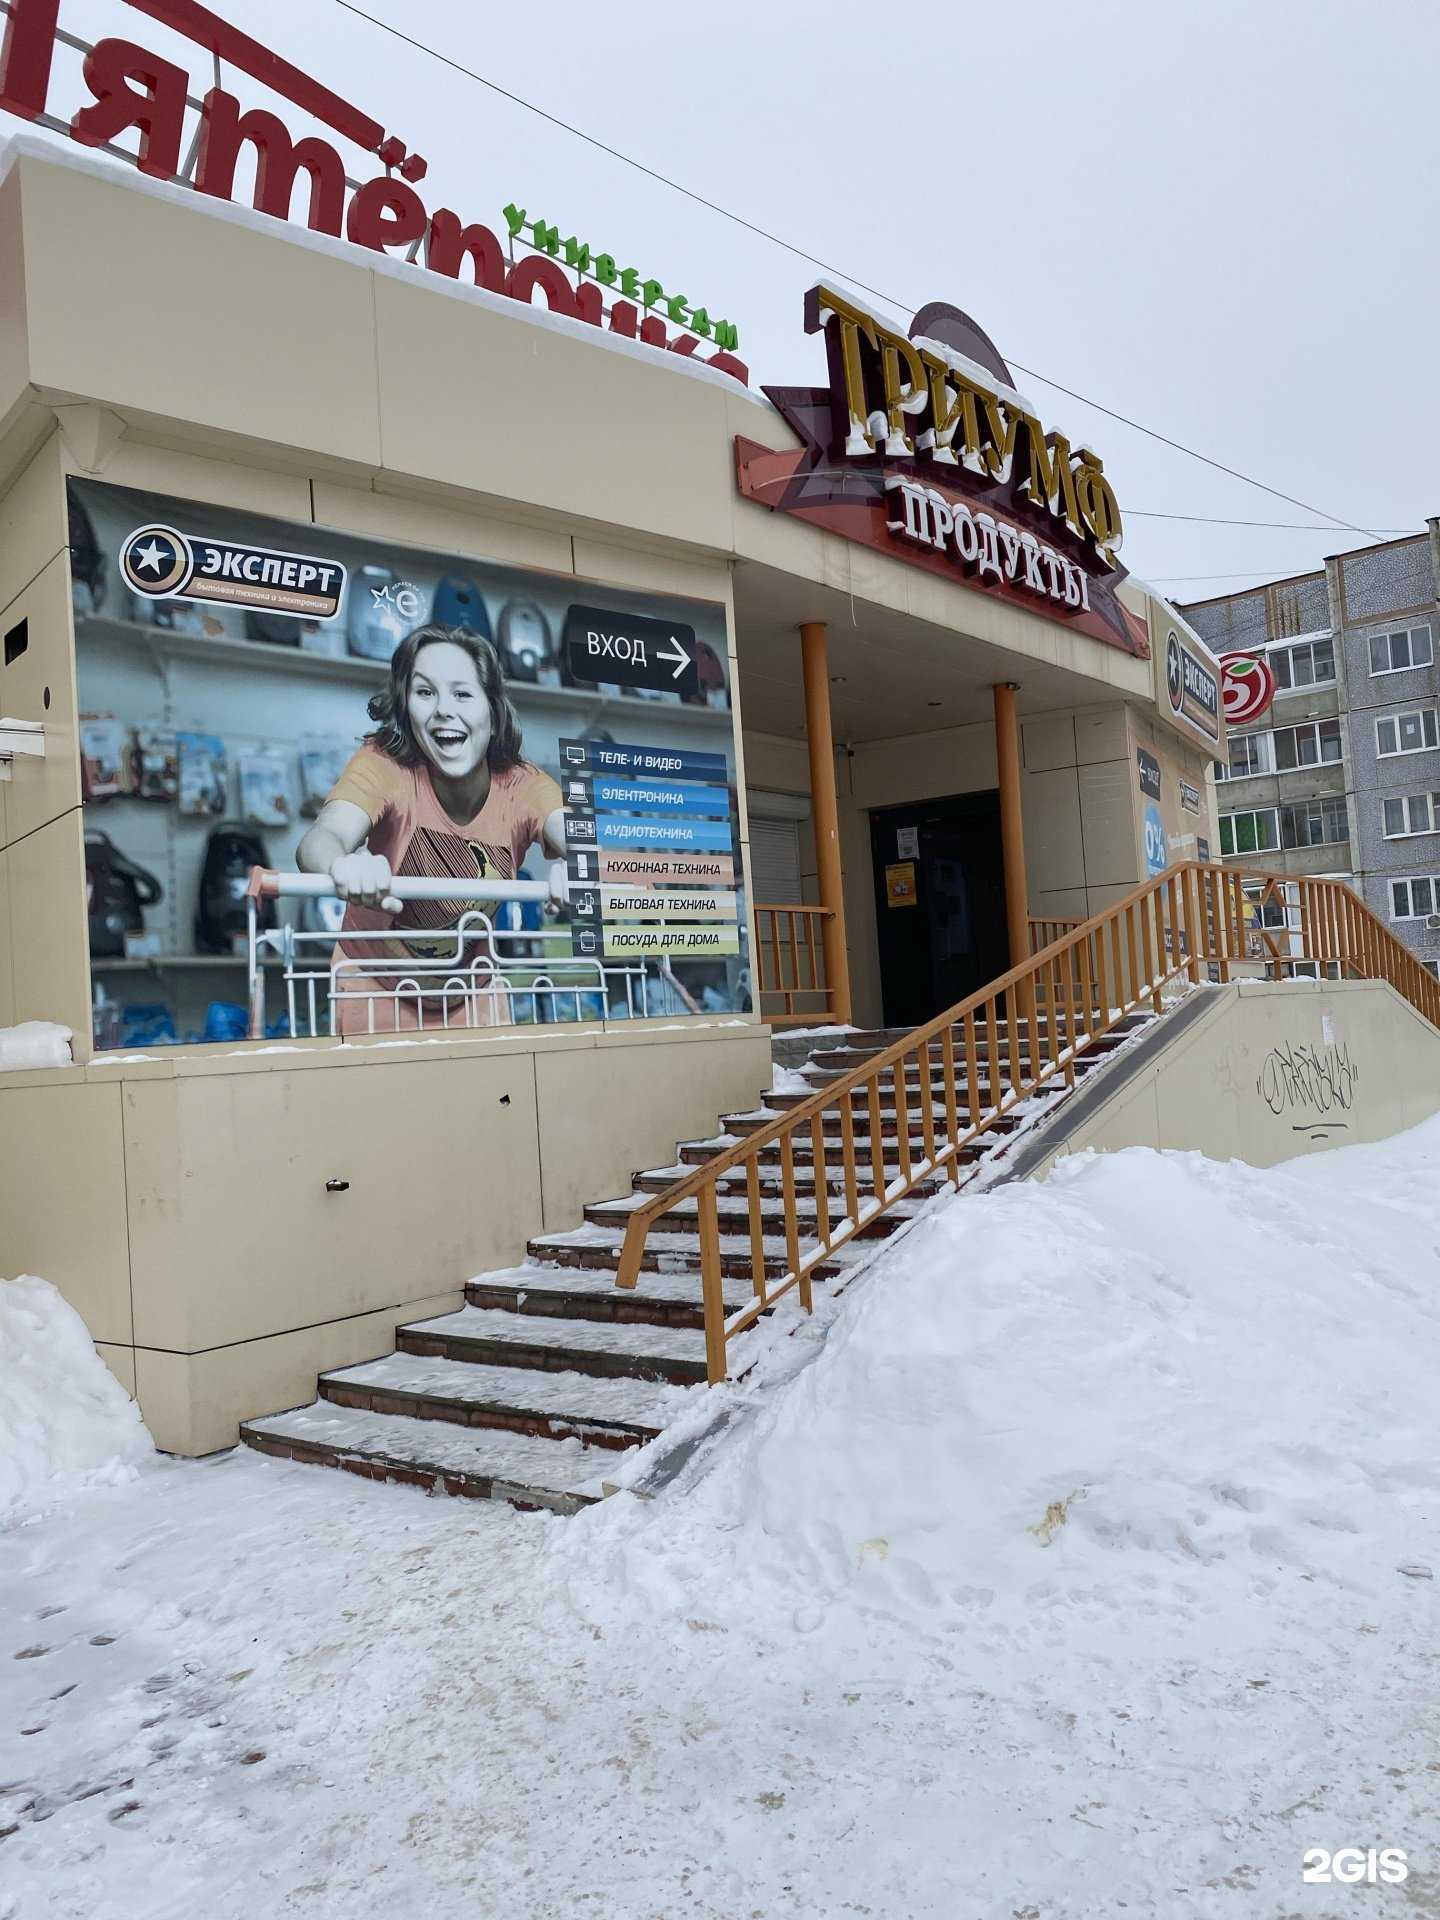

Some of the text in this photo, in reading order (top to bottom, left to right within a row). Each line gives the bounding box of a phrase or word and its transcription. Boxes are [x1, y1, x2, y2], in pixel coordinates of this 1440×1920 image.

[503, 203, 740, 351] УНИВЕРСАМ
[808, 285, 1124, 570] ТРИУМФ
[899, 482, 1091, 613] ПРОДУКТЫ
[200, 547, 336, 593] ЭКСПЕРТ
[587, 631, 647, 667] ВХОД
[1184, 656, 1216, 712] ЭКСПЕРТ
[599, 750, 683, 771] ТЕЛЕ- И ВИДЕО
[601, 787, 685, 806] ЭЛЕКТРОНИКА
[603, 823, 694, 841] АУДИОТЕХНИКА
[606, 860, 722, 876] КУХОННАЯ ТЕХНИКА
[609, 897, 717, 912] БЫТОВАЯ ТЕХНИКА
[611, 933, 721, 949] ПОСУДА ДЛЯ ДОМА
